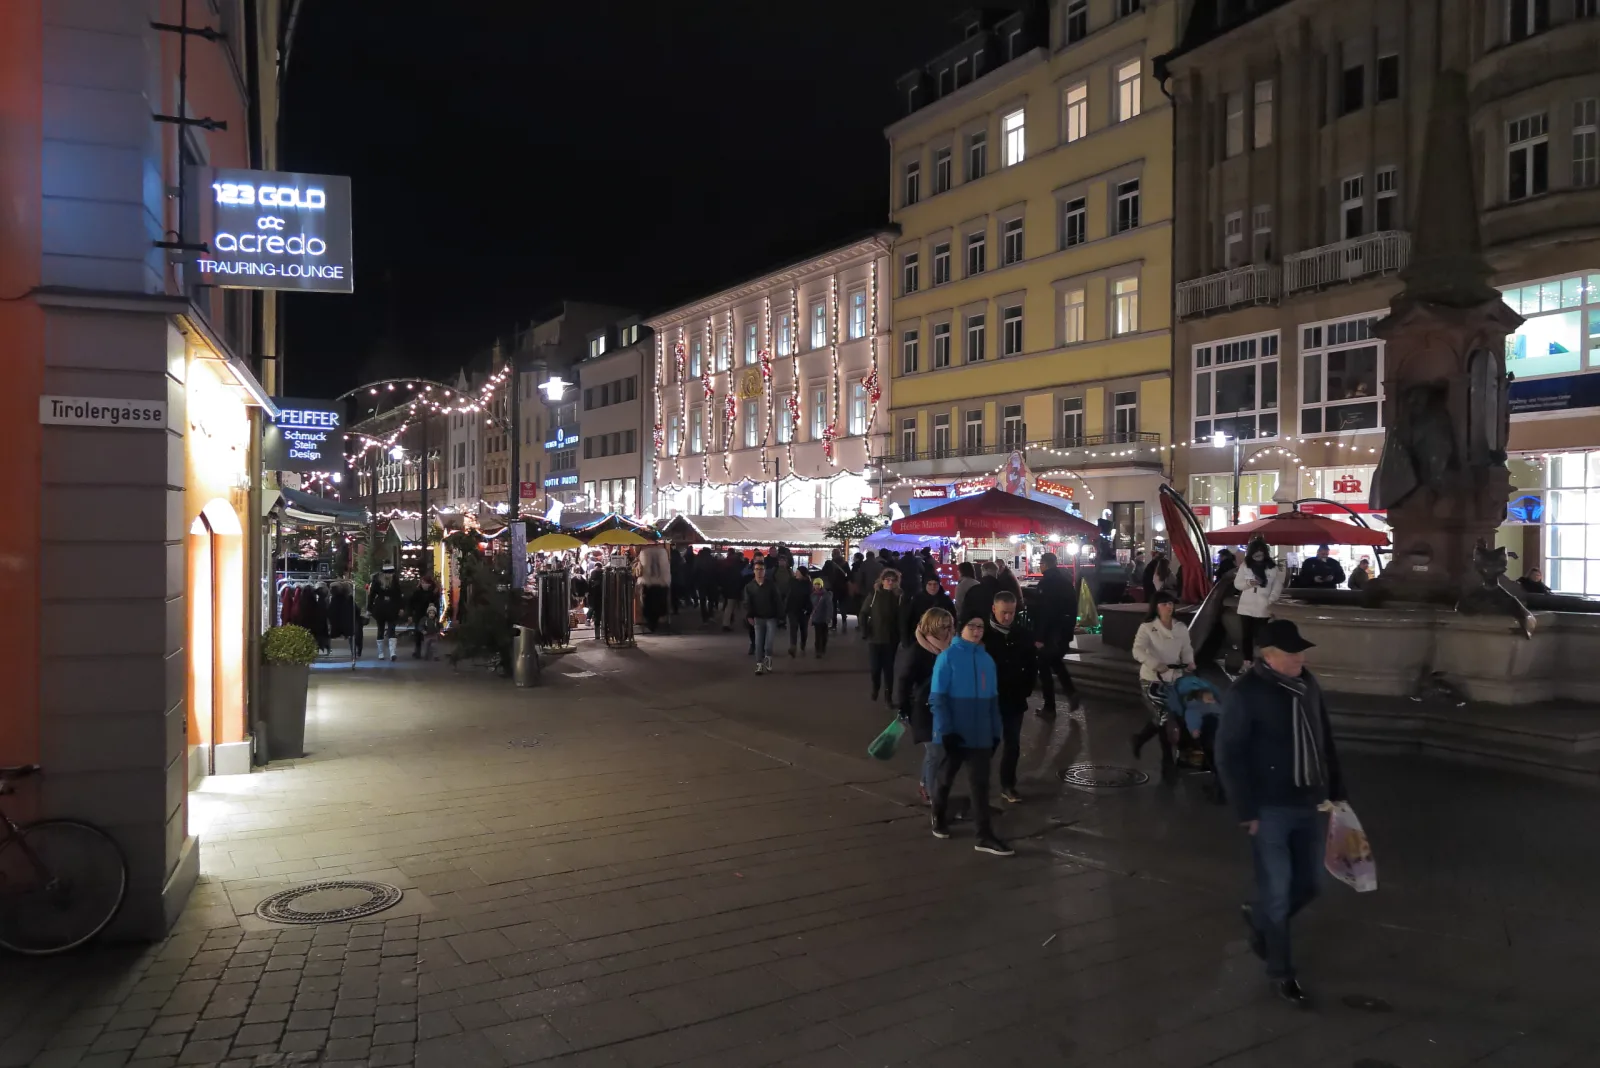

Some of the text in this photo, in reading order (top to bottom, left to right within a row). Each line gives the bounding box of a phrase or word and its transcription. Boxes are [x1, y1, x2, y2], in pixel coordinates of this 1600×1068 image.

[212, 183, 326, 209] 123 GOLD
[214, 231, 326, 255] acredo
[196, 258, 344, 279] TRAURING-LOUNGE
[50, 399, 162, 424] Tirolergasse
[284, 429, 327, 441] Schmuck
[294, 439, 317, 450] Stein
[289, 448, 321, 461] Design
[1332, 479, 1362, 494] DER
